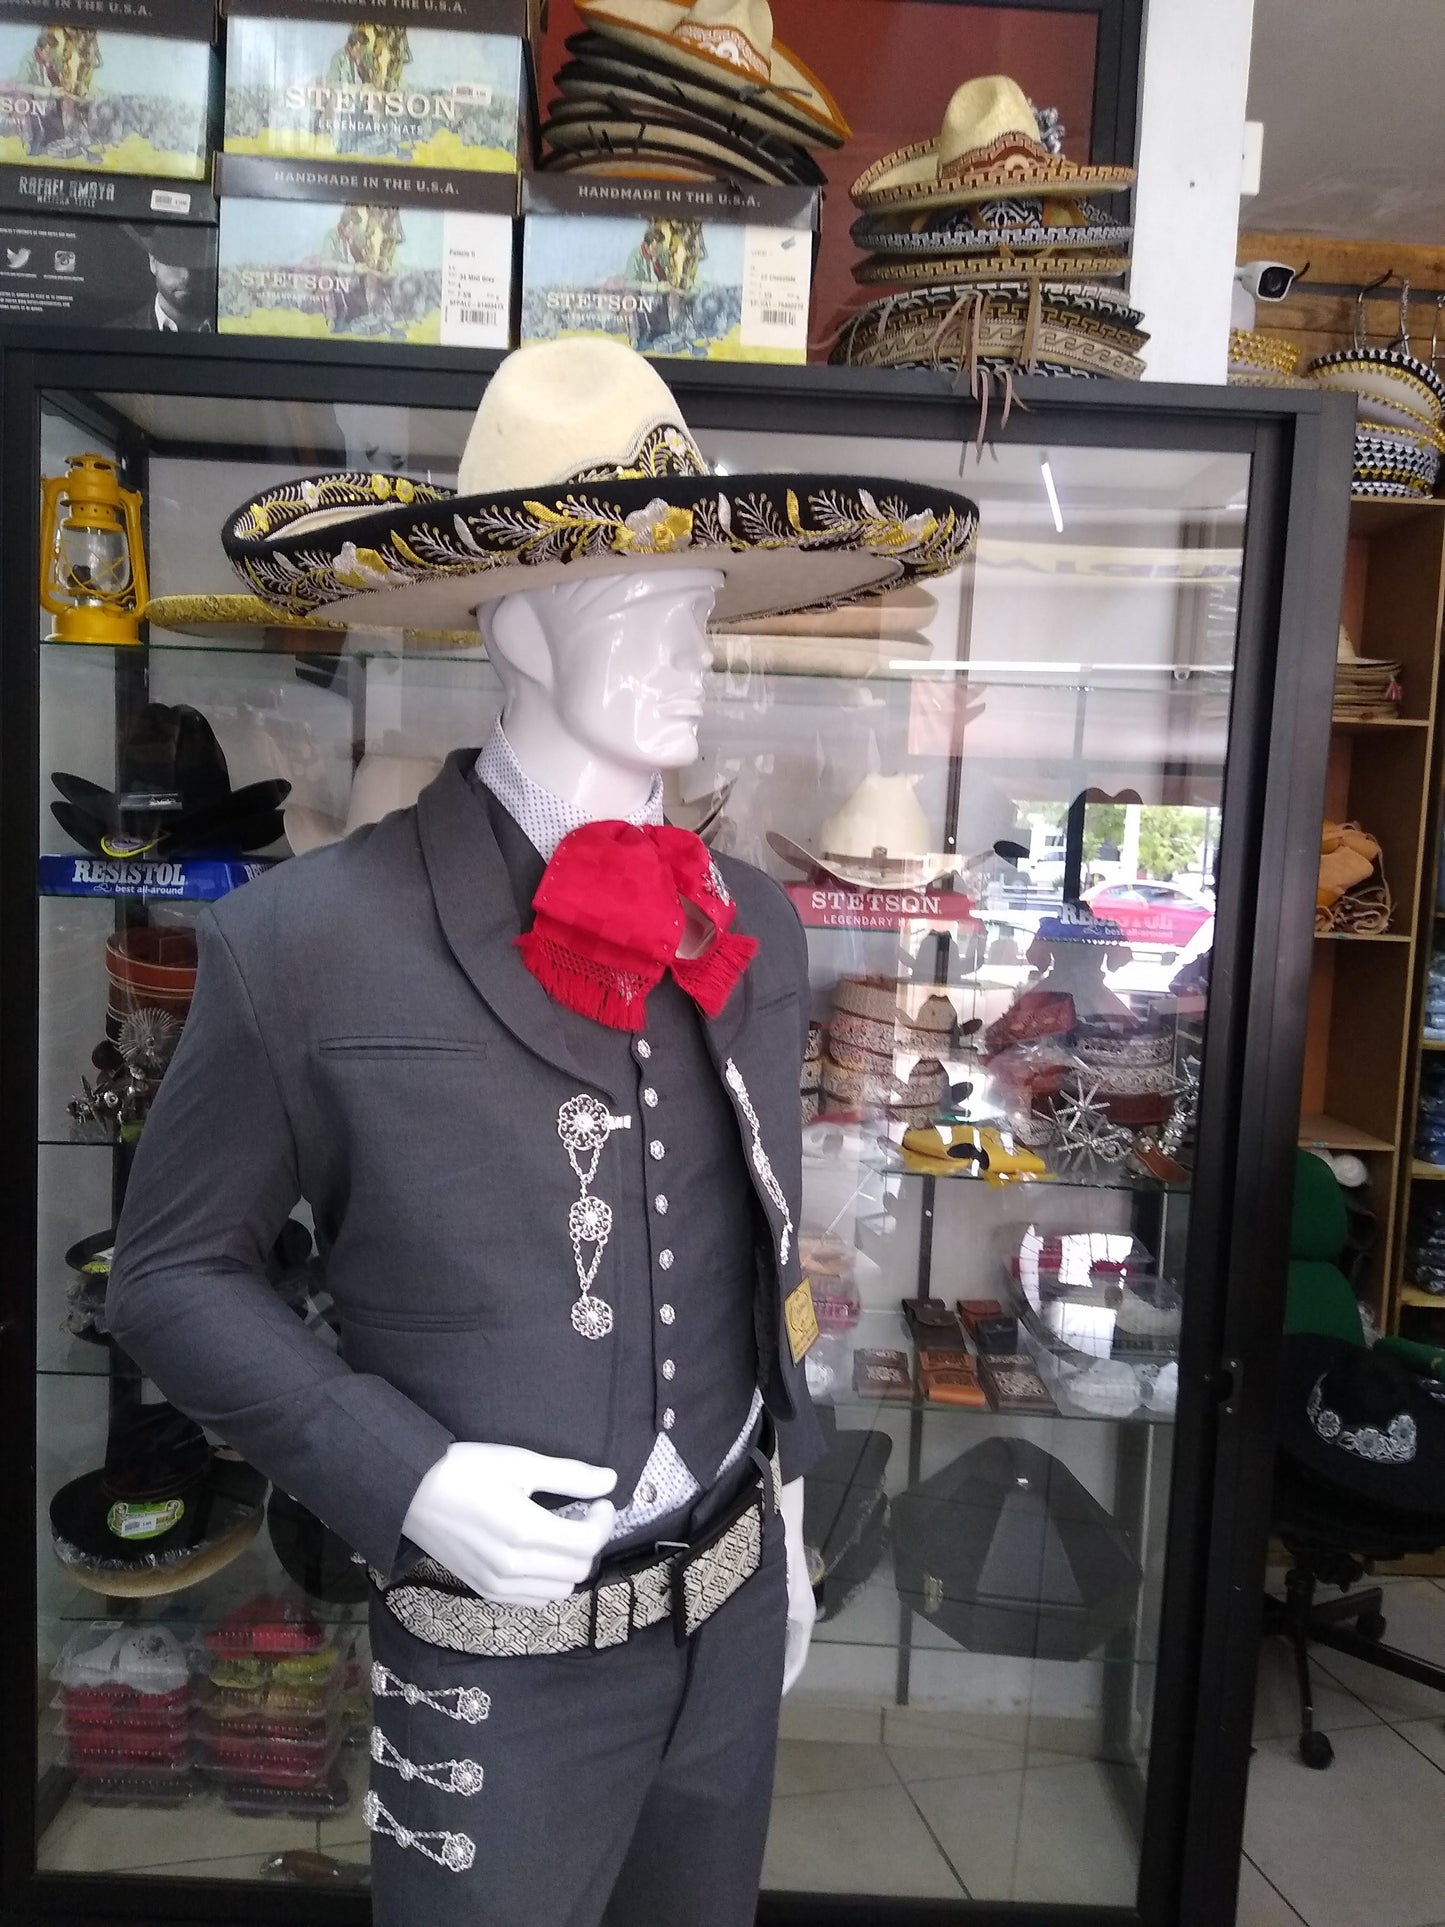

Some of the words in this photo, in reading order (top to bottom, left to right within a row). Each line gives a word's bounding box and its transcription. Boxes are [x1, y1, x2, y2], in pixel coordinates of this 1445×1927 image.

[109, 3, 153, 17] U.S.A.
[425, 1, 468, 15] U.S.A.
[286, 86, 457, 122] STETSON
[318, 119, 388, 133] LEGENDARY
[18, 175, 65, 197] RAFAEL
[69, 180, 115, 202] AMAYA
[274, 171, 358, 187] HANDMADE
[363, 176, 379, 189] IN
[383, 178, 411, 191] THE
[416, 181, 460, 195] U.S.A.
[578, 185, 661, 200] HANDMADE
[666, 190, 681, 202] IN
[686, 191, 714, 205] THE
[718, 193, 761, 208] U.S.A.
[241, 270, 351, 294] STETSON
[546, 291, 655, 314] STETSON
[72, 859, 186, 886] RESISTOL
[114, 885, 135, 894] best
[136, 884, 184, 896] all-around
[811, 891, 941, 915] STETSON
[823, 914, 893, 928] LEGENDARY
